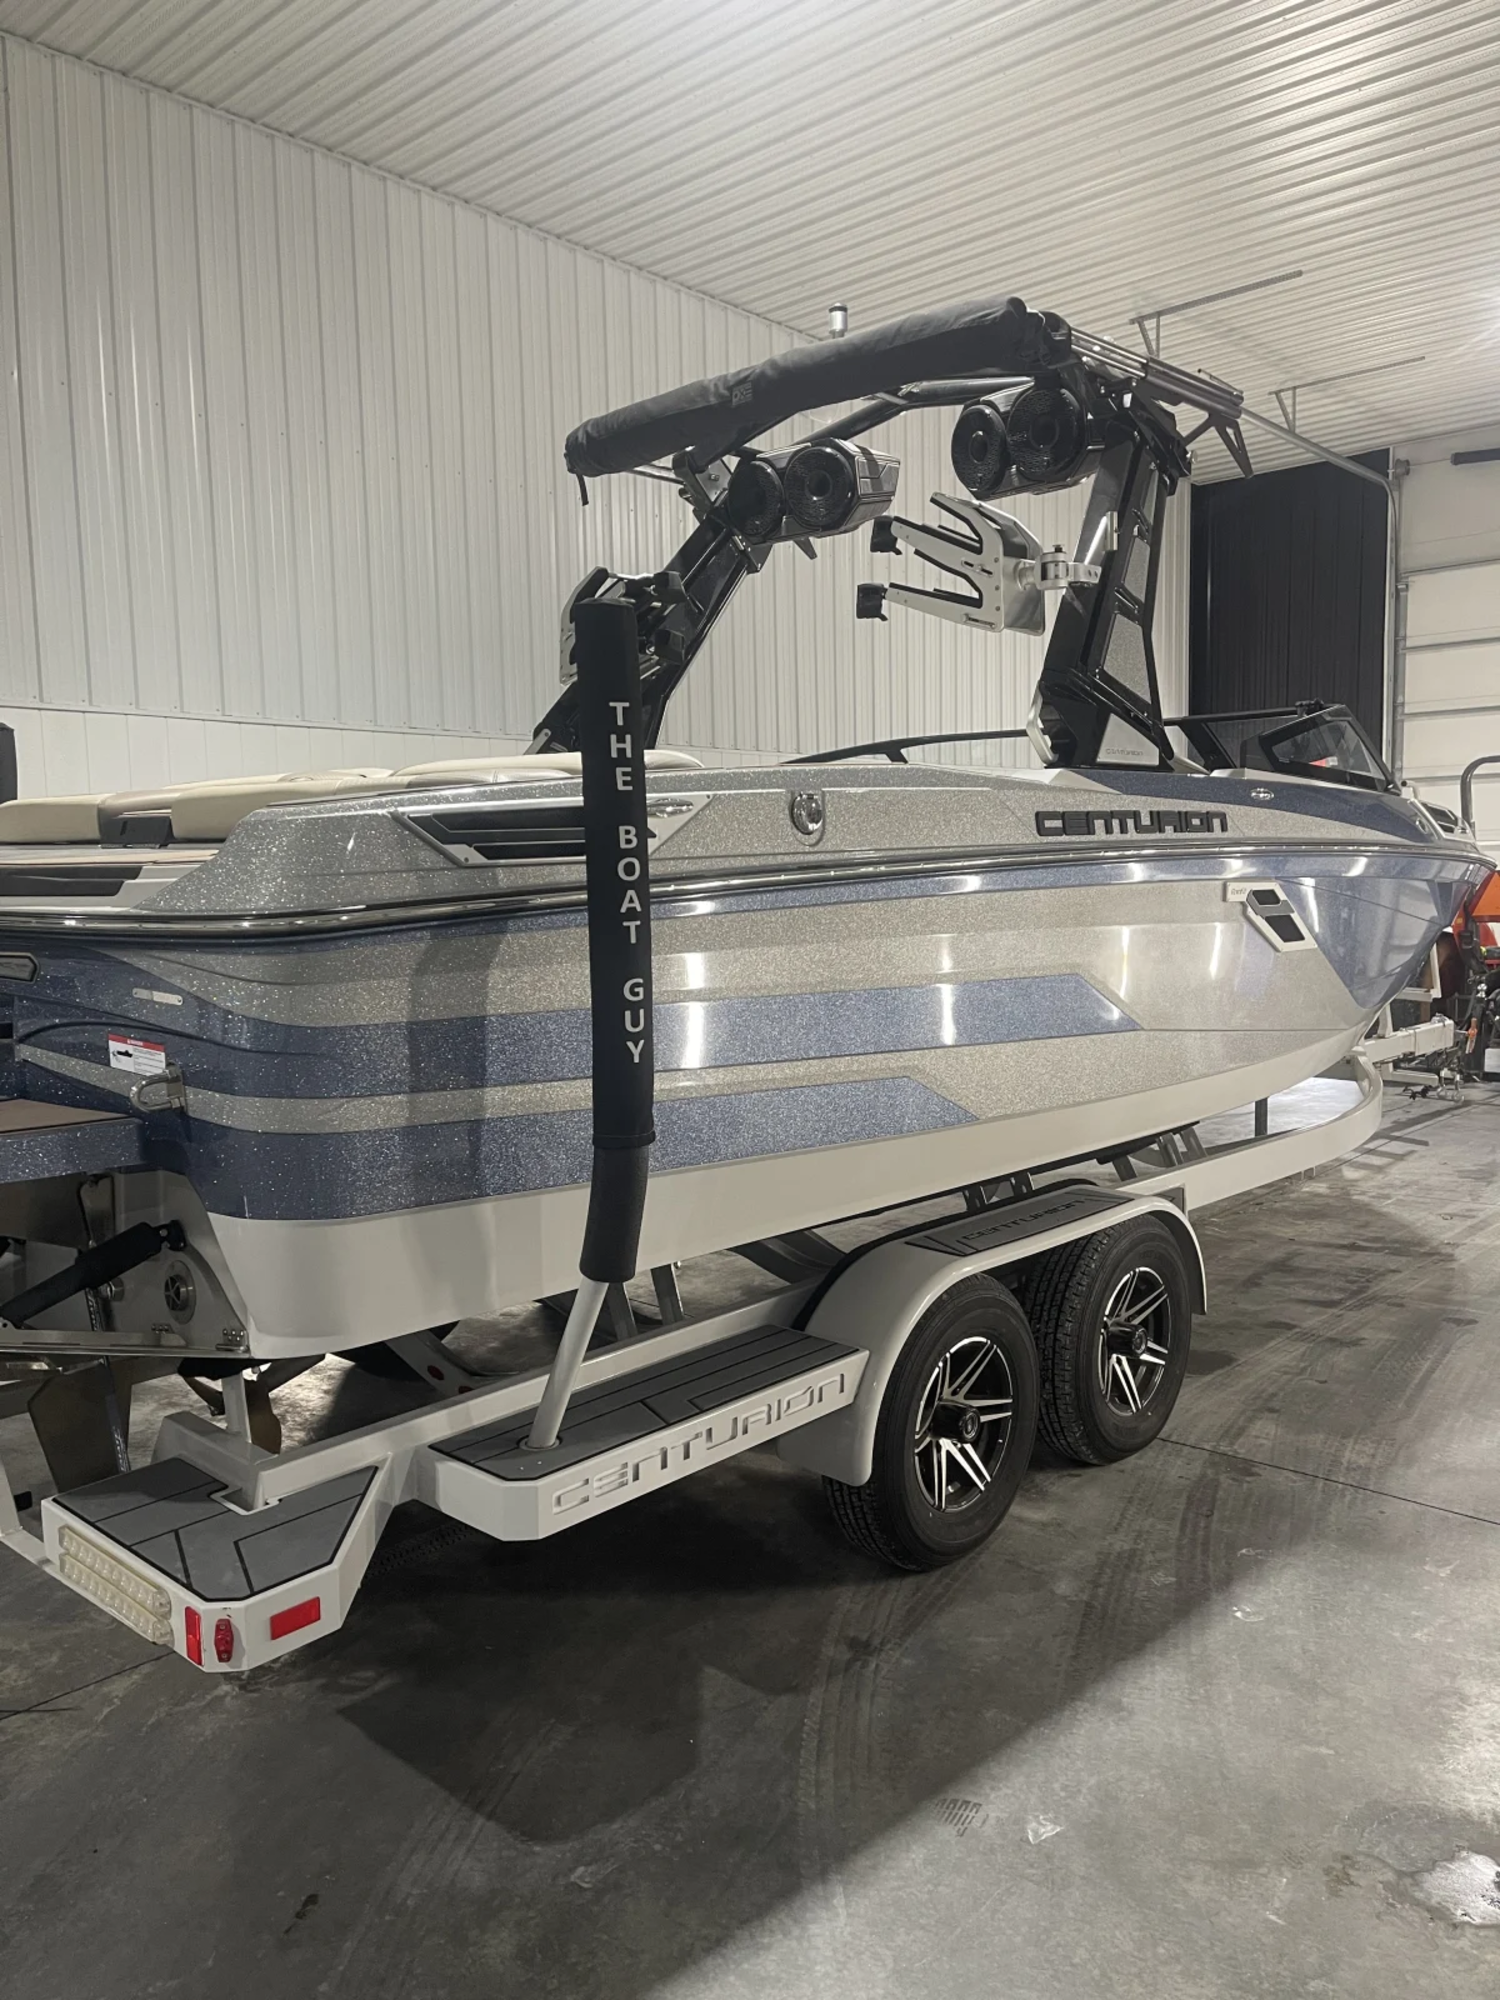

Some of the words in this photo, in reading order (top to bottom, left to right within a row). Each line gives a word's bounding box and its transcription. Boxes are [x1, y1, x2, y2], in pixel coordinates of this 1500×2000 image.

[608, 701, 634, 791] THE
[1035, 810, 1228, 837] CENTURION
[617, 825, 642, 944] BOAT
[623, 977, 646, 1063] GUY
[962, 1199, 1086, 1241] CENTURION
[552, 1373, 846, 1515] CENTURION
